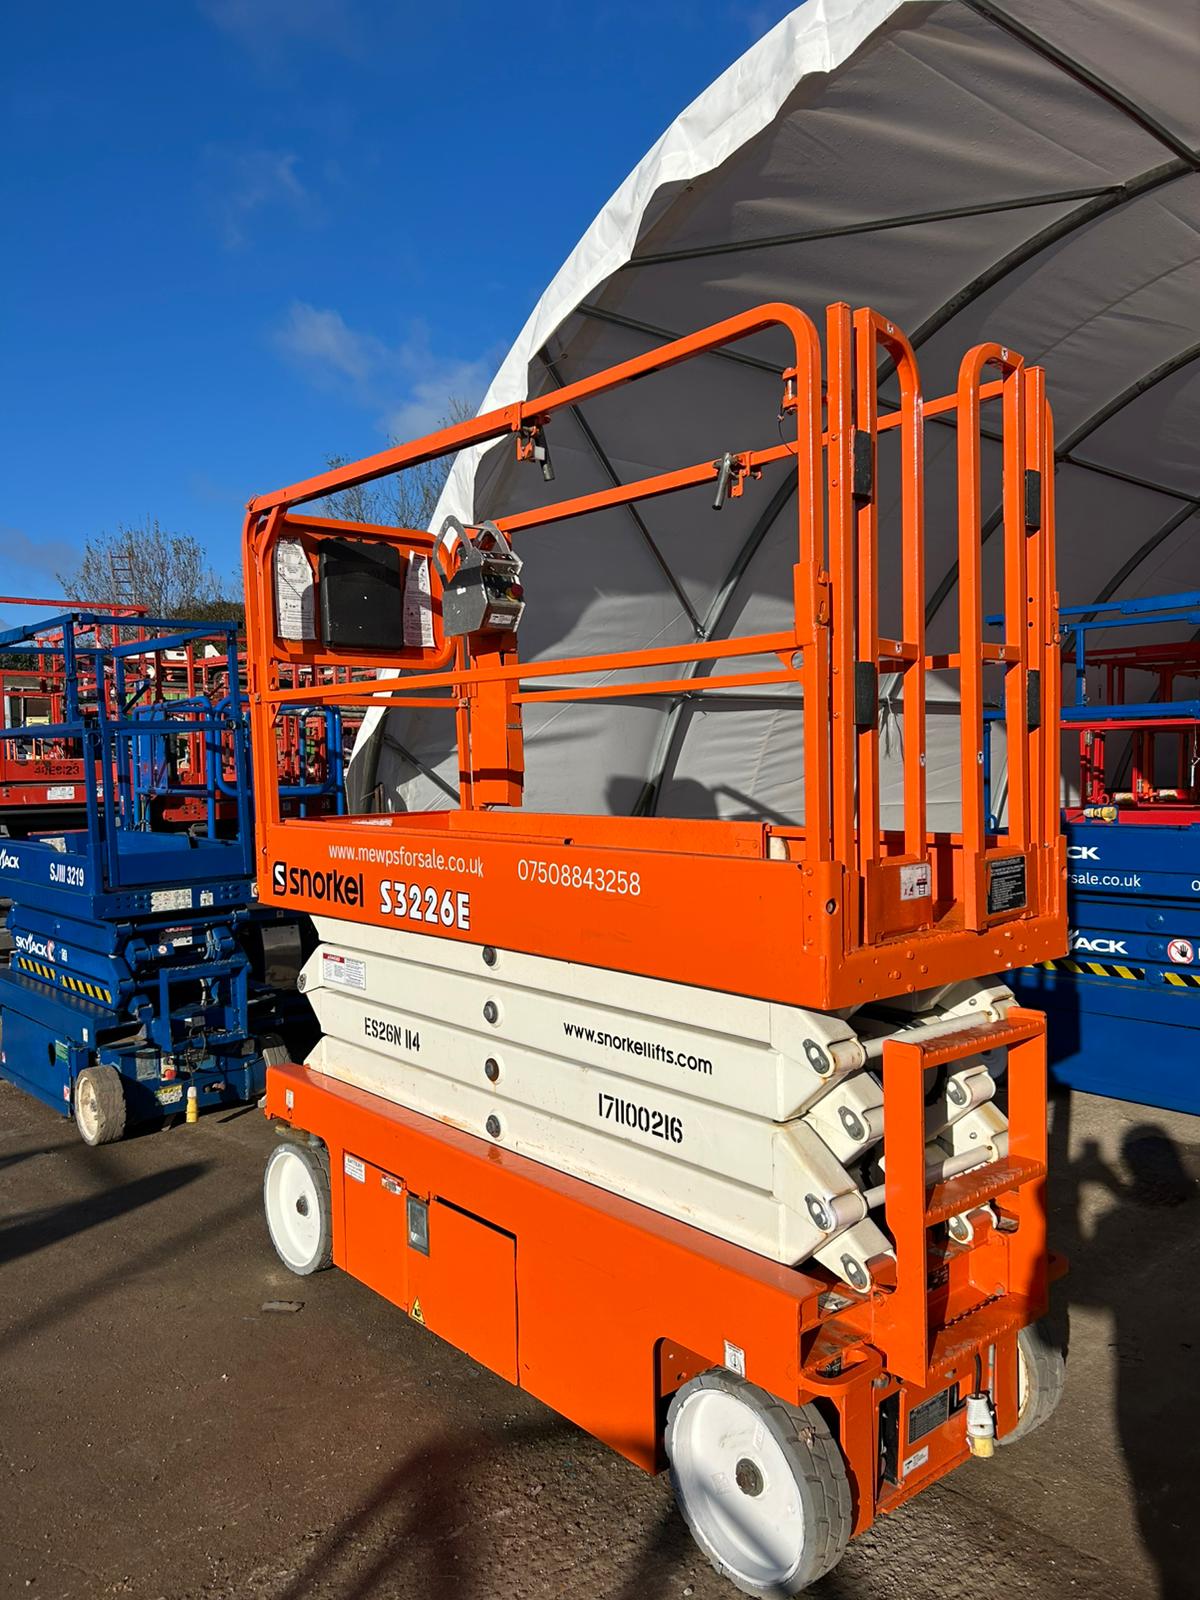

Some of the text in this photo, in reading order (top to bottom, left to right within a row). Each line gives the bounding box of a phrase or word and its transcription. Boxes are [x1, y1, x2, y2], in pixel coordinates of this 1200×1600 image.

[66, 866, 85, 887] 3219
[328, 844, 484, 877] www.mewpsforsale.co.uk
[517, 859, 641, 896] 07508843258
[289, 866, 364, 908] snorkel
[379, 879, 470, 931] S3226E
[364, 1016, 402, 1047] ES26N
[563, 1022, 713, 1075] www.snorkellifts.com
[598, 1093, 683, 1144] 171100216
